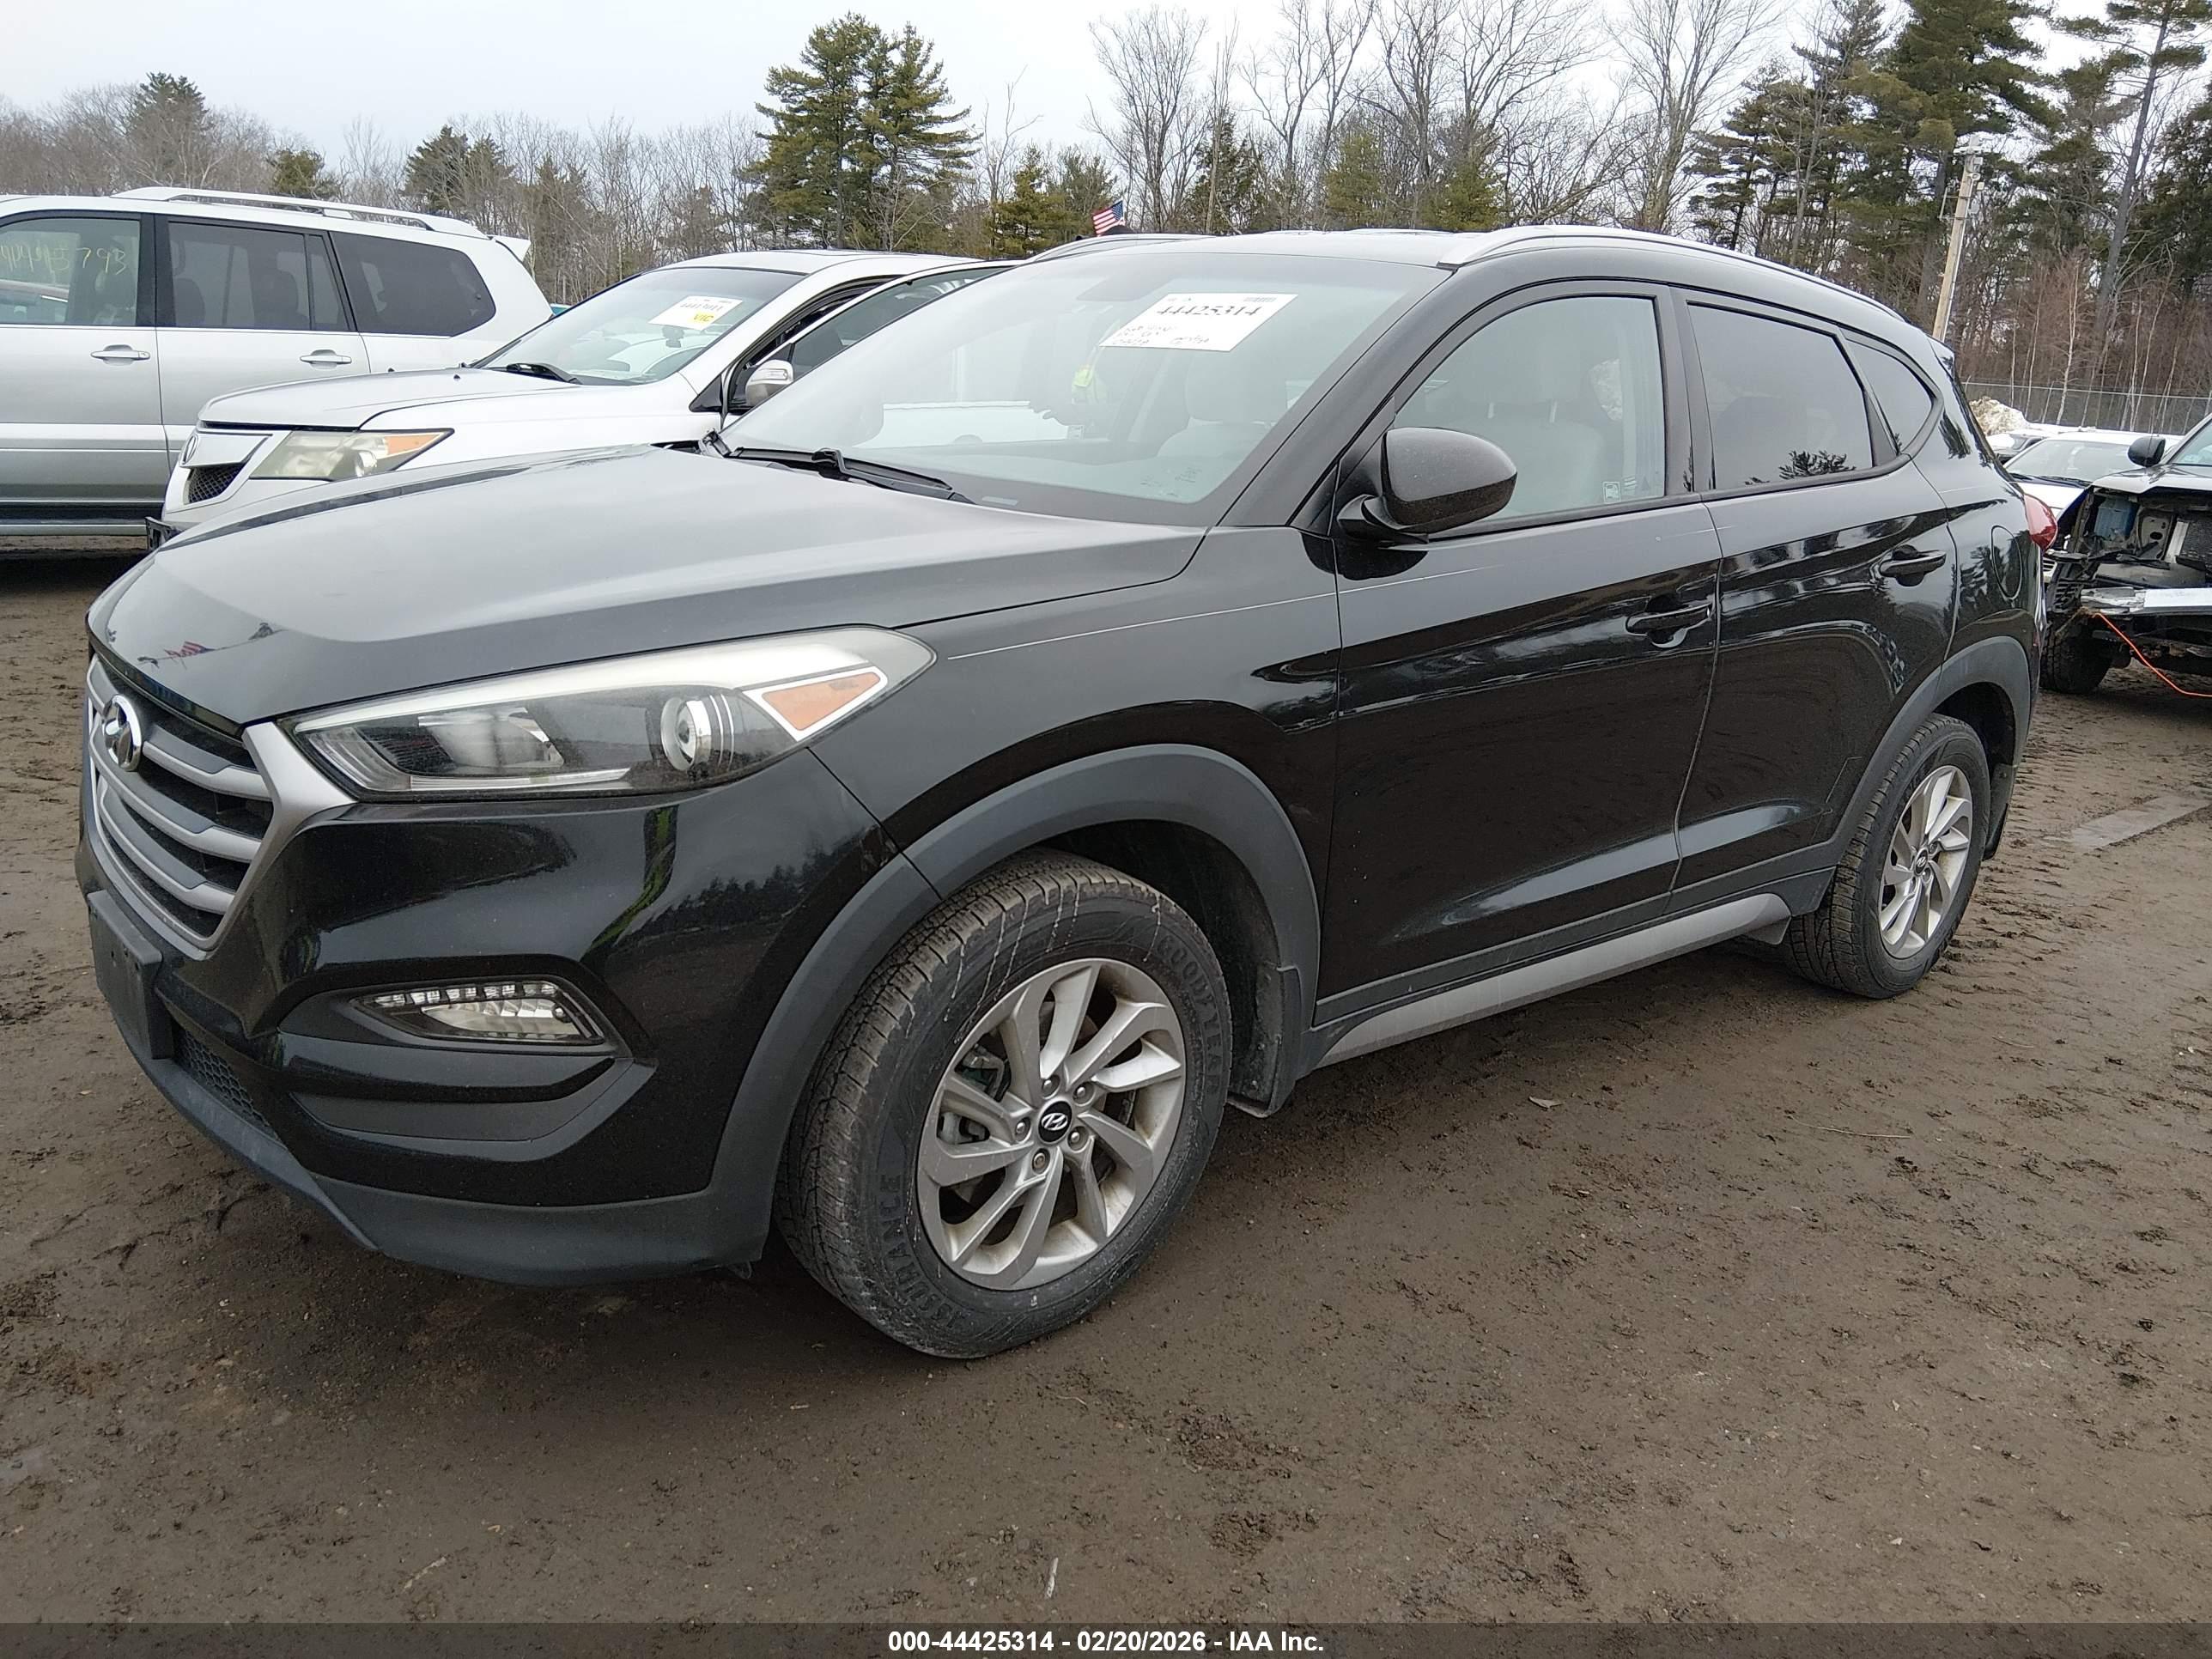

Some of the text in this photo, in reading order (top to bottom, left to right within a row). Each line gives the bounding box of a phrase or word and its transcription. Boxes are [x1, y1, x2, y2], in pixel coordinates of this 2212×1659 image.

[1157, 305, 1262, 317] 44425314
[1157, 935, 1222, 1094] GOODYEAR
[880, 1172, 965, 1328] ASSURANCE
